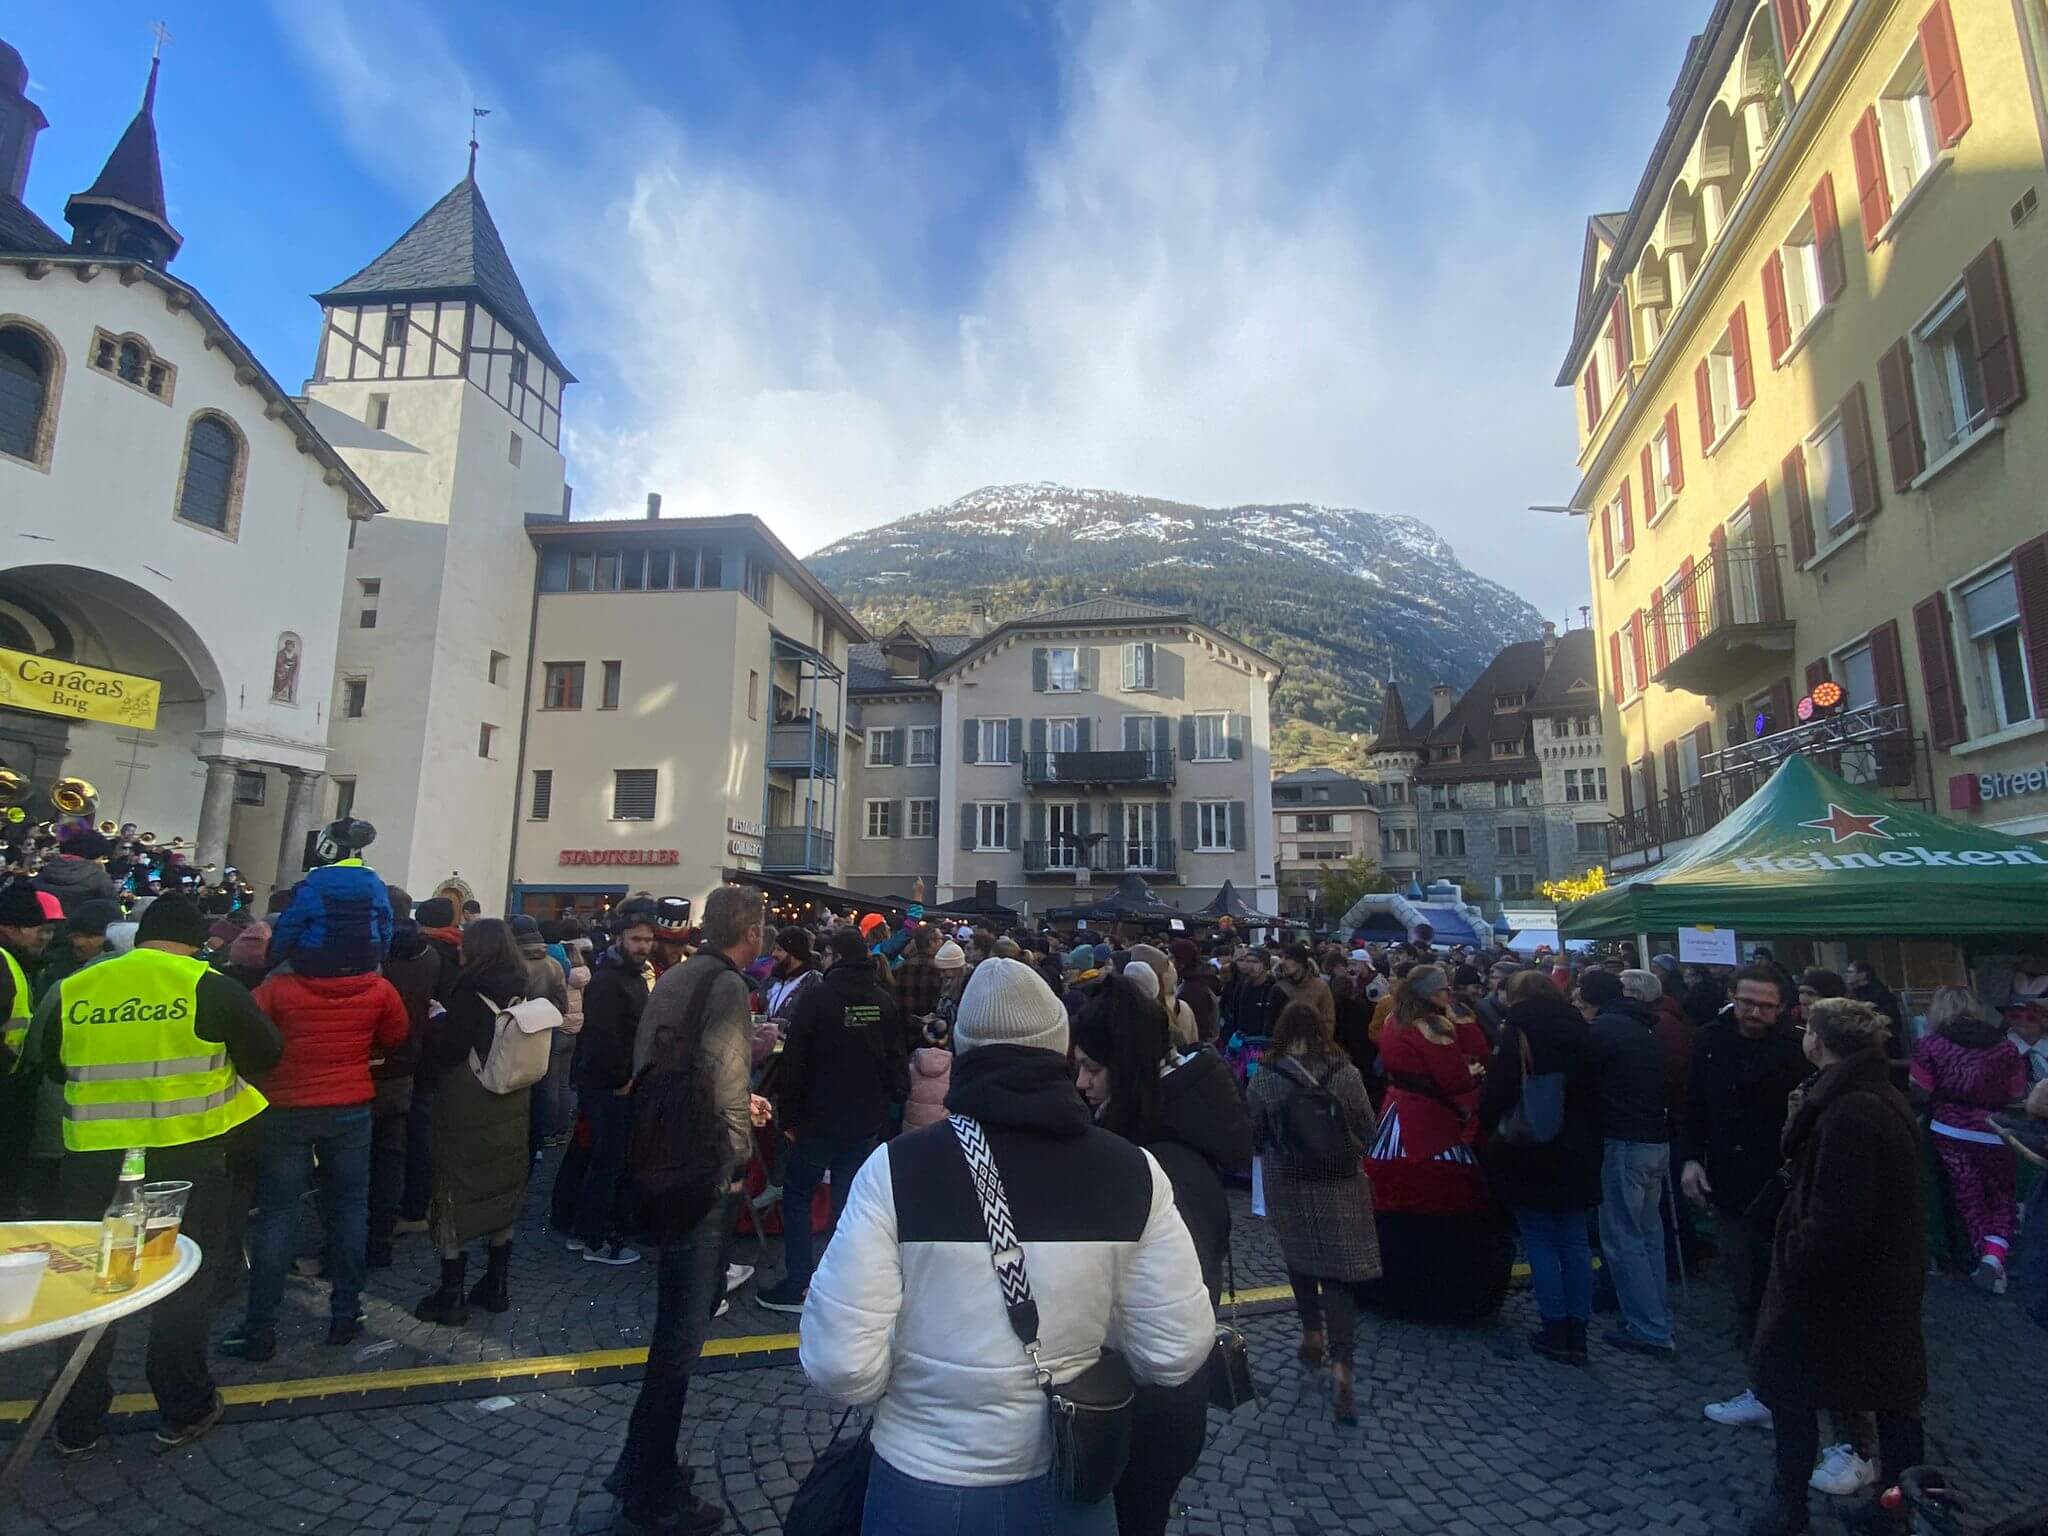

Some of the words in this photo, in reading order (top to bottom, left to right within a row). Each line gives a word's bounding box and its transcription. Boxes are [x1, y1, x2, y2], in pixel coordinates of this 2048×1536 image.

[52, 691, 88, 713] Brig
[560, 849, 680, 865] STADTKELLER
[1732, 846, 2048, 874] Heineken
